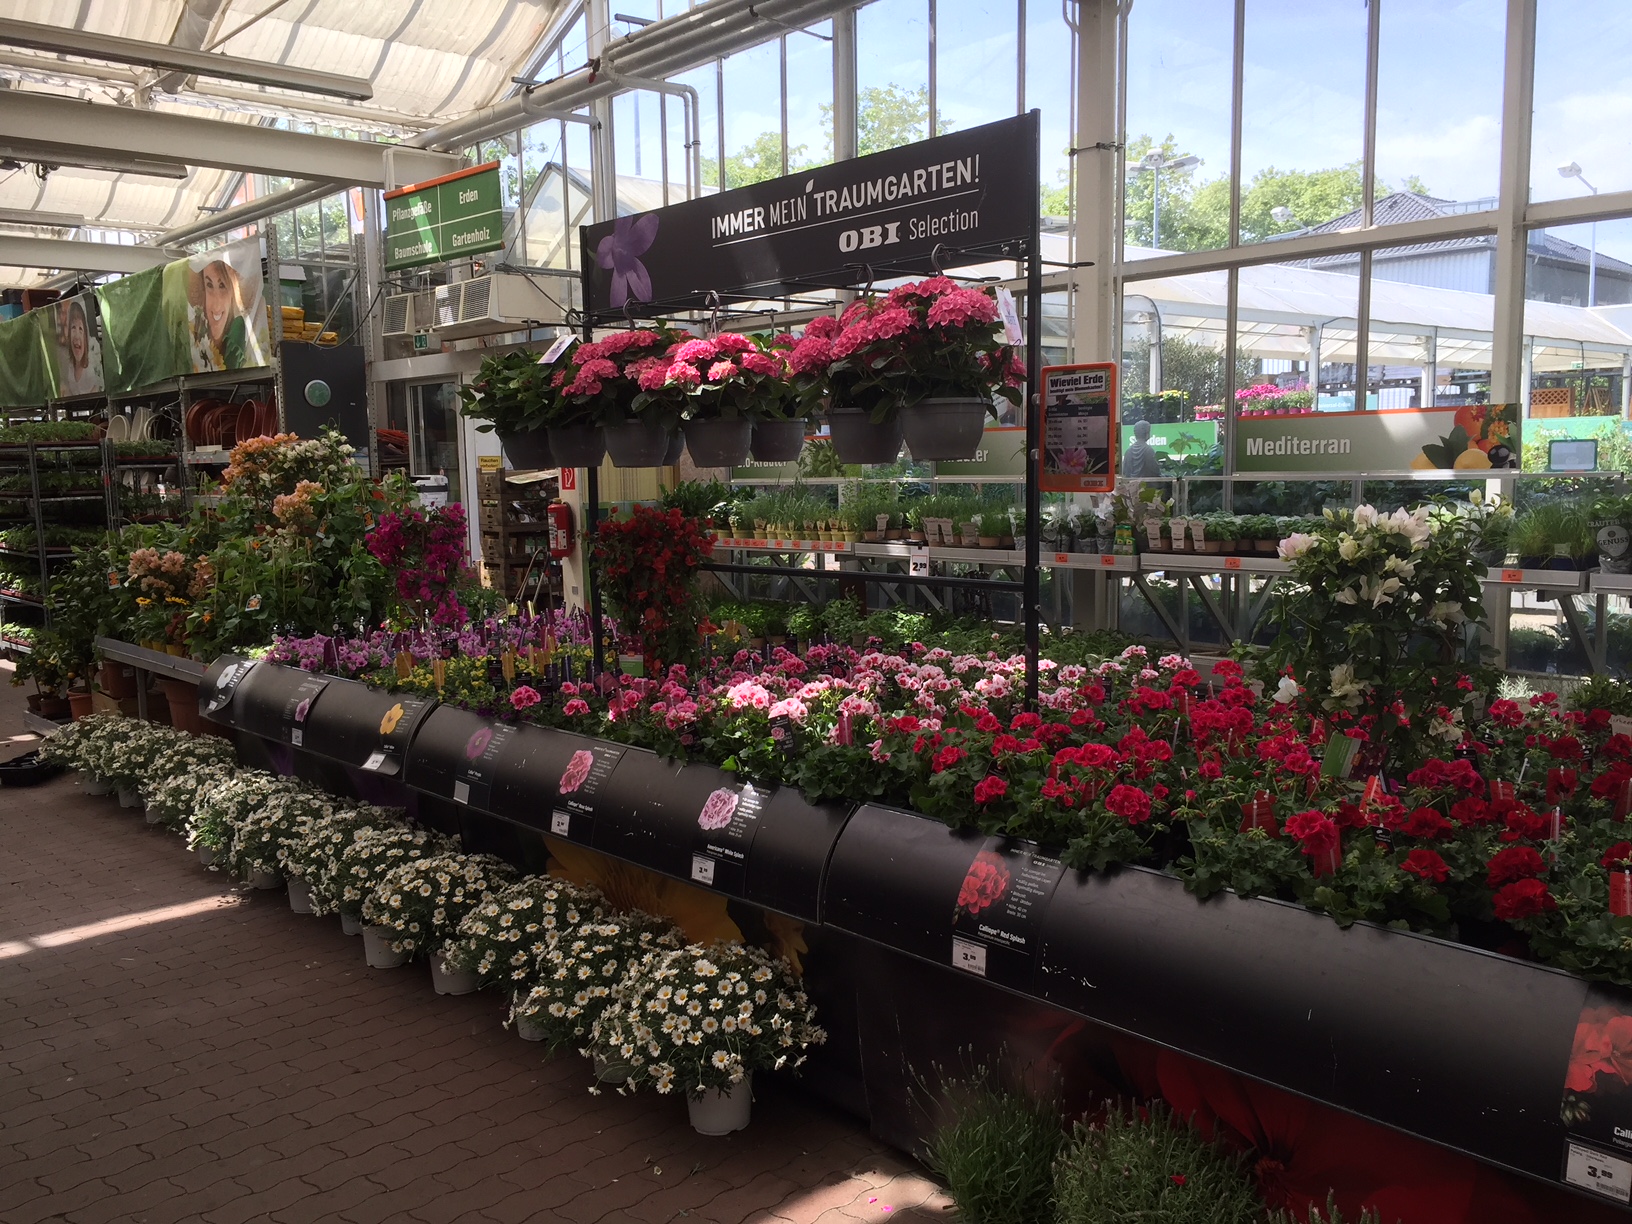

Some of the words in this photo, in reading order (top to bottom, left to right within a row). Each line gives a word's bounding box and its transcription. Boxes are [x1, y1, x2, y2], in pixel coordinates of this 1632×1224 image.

[459, 189, 478, 204] Erden
[712, 206, 765, 239] IMMER
[769, 195, 807, 227] MEIN
[813, 154, 980, 216] TRAUMGARTEN!
[393, 201, 432, 221] Pflanzgefäße
[452, 227, 490, 246] Gartenholz
[838, 221, 901, 253] OBI
[909, 208, 979, 240] Selection
[394, 240, 433, 260] Baumschule
[1050, 376, 1081, 388] Wieviel
[1083, 374, 1103, 384] Erde
[1246, 436, 1351, 456] Mediterran
[1598, 536, 1629, 546] GENUSS
[1000, 930, 1010, 939] Red
[1010, 934, 1026, 945] Splash
[1587, 1165, 1614, 1180] 3,99
